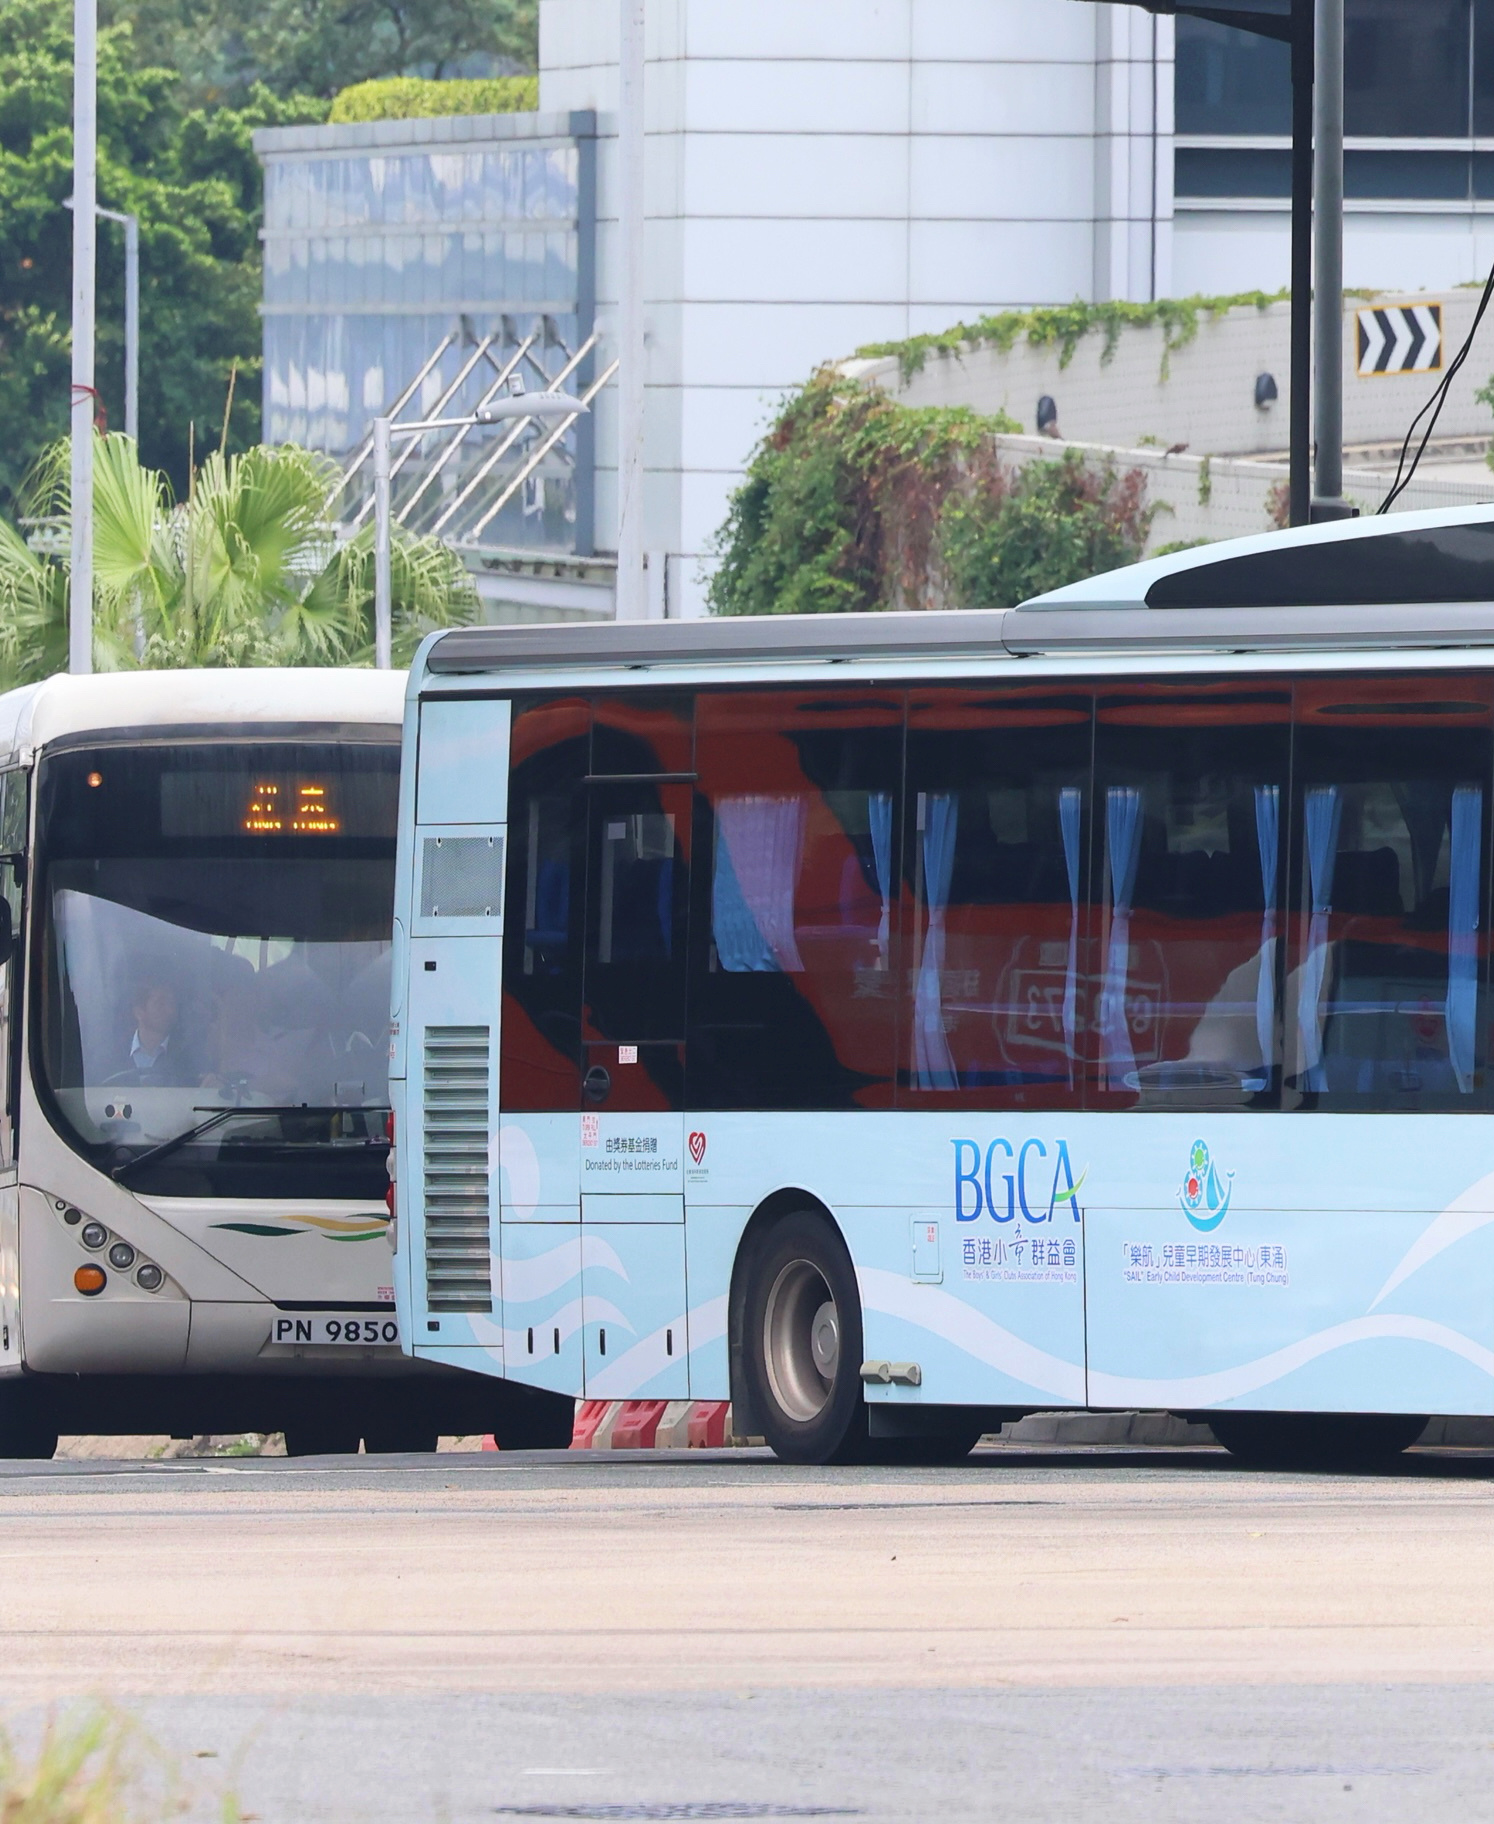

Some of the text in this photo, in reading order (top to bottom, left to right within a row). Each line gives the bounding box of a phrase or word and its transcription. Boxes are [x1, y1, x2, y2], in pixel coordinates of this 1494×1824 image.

[585, 1158, 678, 1173] Donated by the Lotteries Fund
[950, 1137, 1089, 1224] BGCA
[962, 1223, 1077, 1266] 香港小童群益會
[963, 1269, 972, 1279] The
[985, 1270, 990, 1280] &
[1004, 1270, 1017, 1280] Clubs
[1018, 1271, 1044, 1281] Association
[1044, 1271, 1050, 1281] of
[1051, 1271, 1064, 1283] Hong
[1064, 1271, 1077, 1283] Kong
[1146, 1270, 1163, 1284] Early
[1163, 1270, 1180, 1282] Child
[1181, 1270, 1222, 1284] Development
[1223, 1271, 1244, 1283] Centre
[1247, 1271, 1265, 1285] (Tung
[1266, 1272, 1289, 1286] Chung)
[276, 1320, 398, 1343] PN 9850
